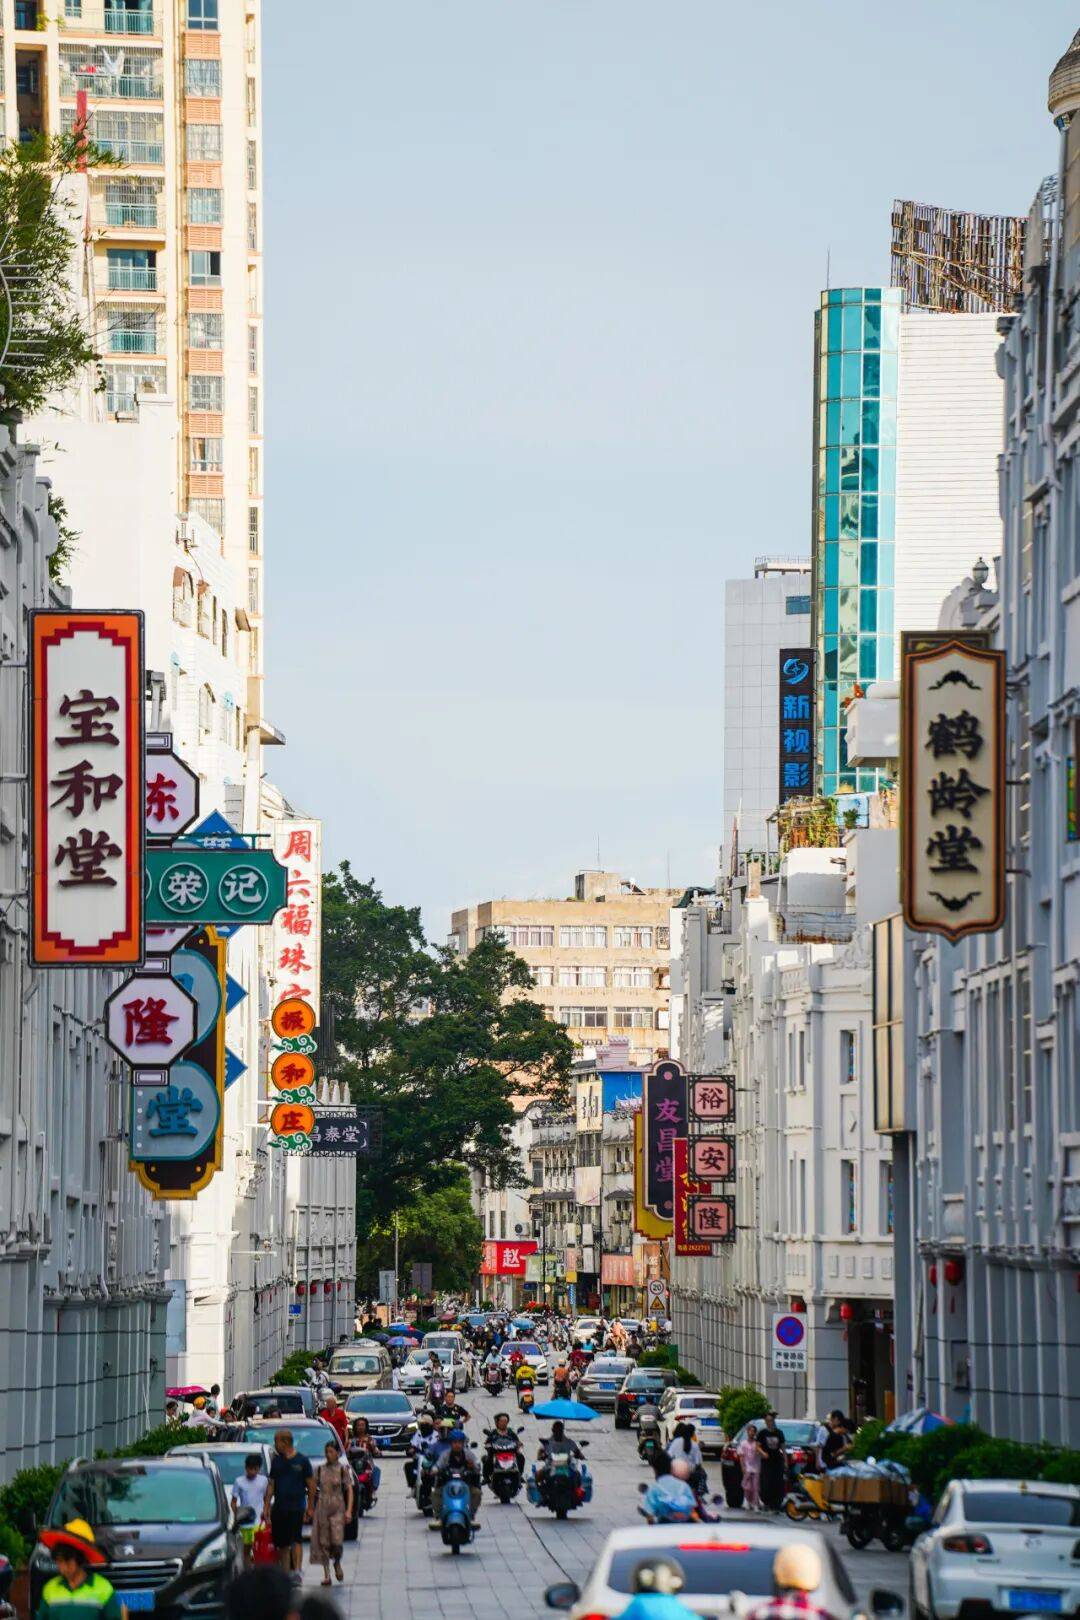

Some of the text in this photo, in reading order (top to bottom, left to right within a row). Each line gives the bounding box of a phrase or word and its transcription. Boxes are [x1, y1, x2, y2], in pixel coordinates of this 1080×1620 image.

[50, 689, 124, 888] 宝和堂
[784, 695, 810, 803] 新视影
[925, 710, 991, 875] 鹤龄堂
[697, 1087, 725, 1231] 裕安隆
